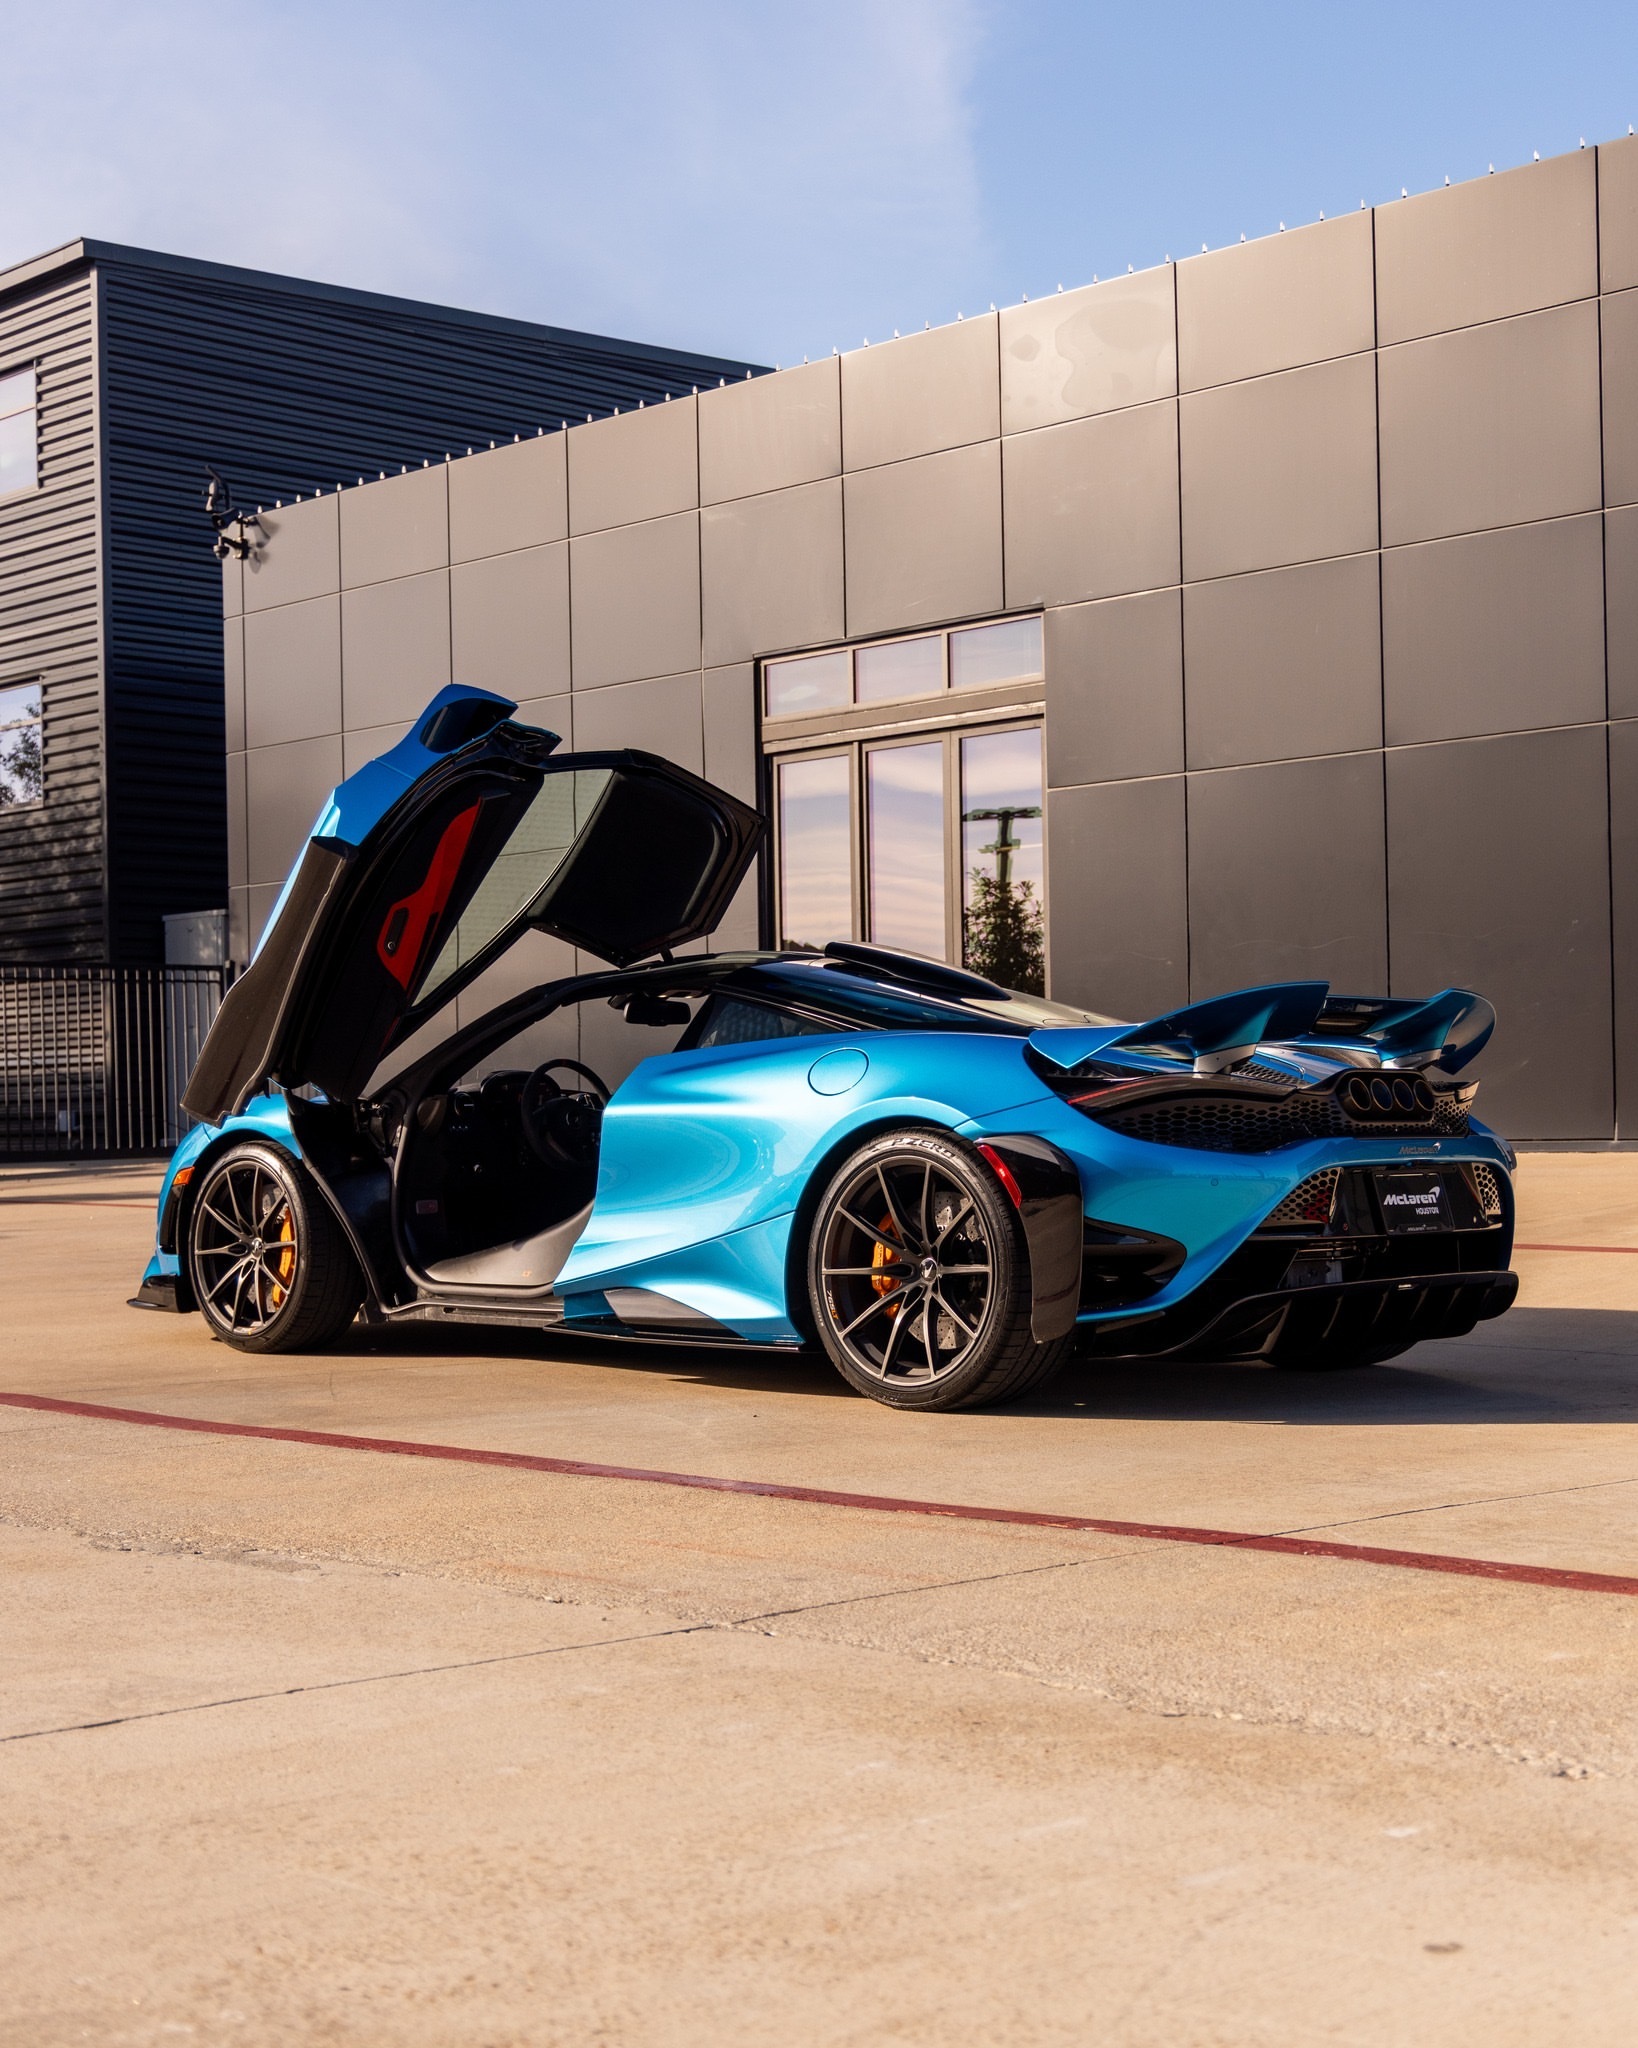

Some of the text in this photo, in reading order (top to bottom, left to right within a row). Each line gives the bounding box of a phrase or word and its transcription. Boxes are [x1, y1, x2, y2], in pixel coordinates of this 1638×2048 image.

[1399, 1145, 1439, 1154] McLaren
[1383, 1192, 1438, 1206] McLaren
[1416, 1206, 1439, 1215] HOUSTON
